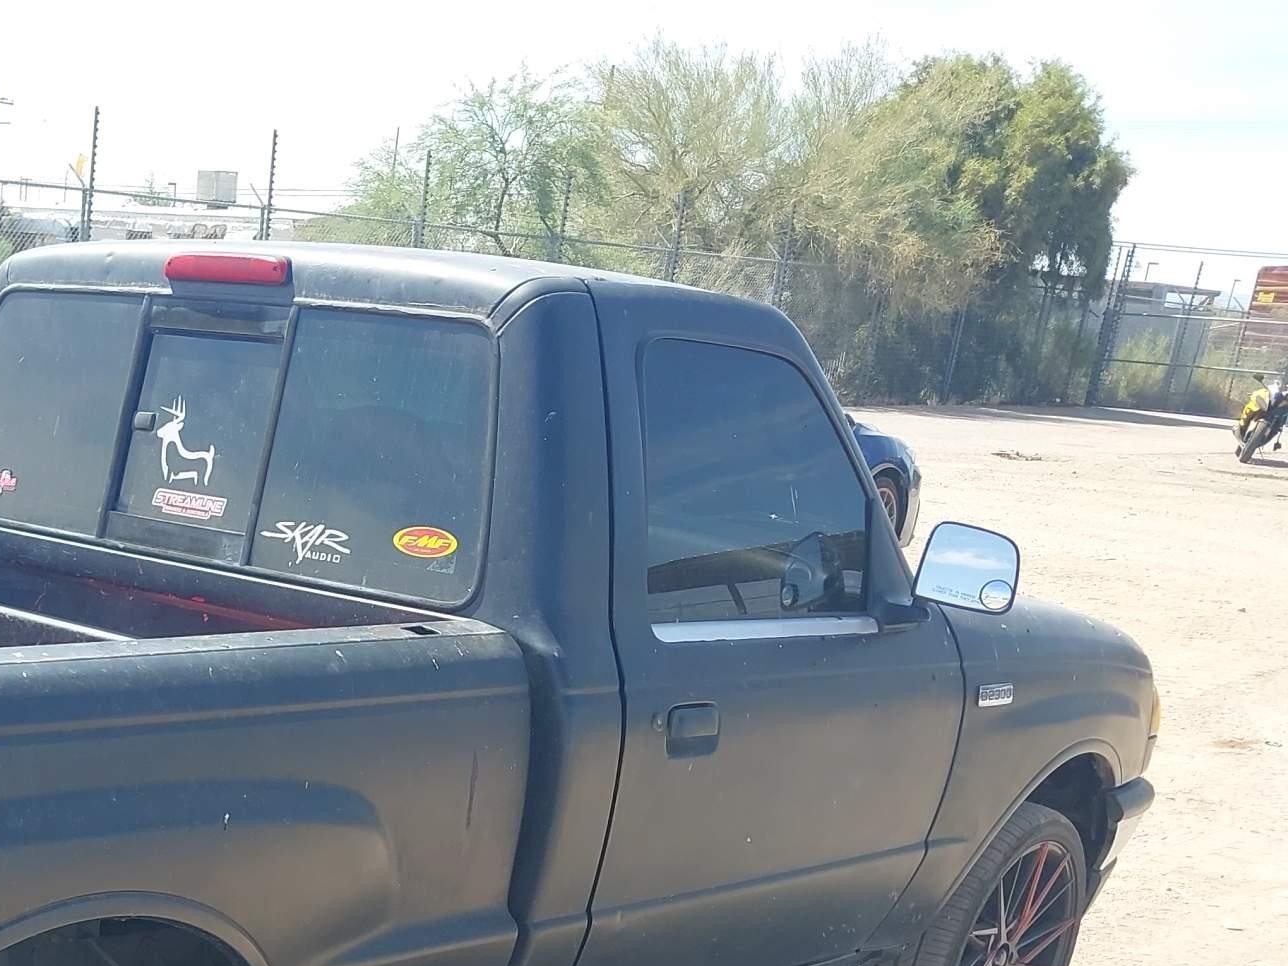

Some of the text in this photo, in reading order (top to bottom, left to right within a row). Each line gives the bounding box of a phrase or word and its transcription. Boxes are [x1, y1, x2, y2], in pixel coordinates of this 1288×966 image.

[260, 521, 352, 565] SKAR
[398, 534, 452, 549] FMF
[304, 550, 342, 563] AUDIO
